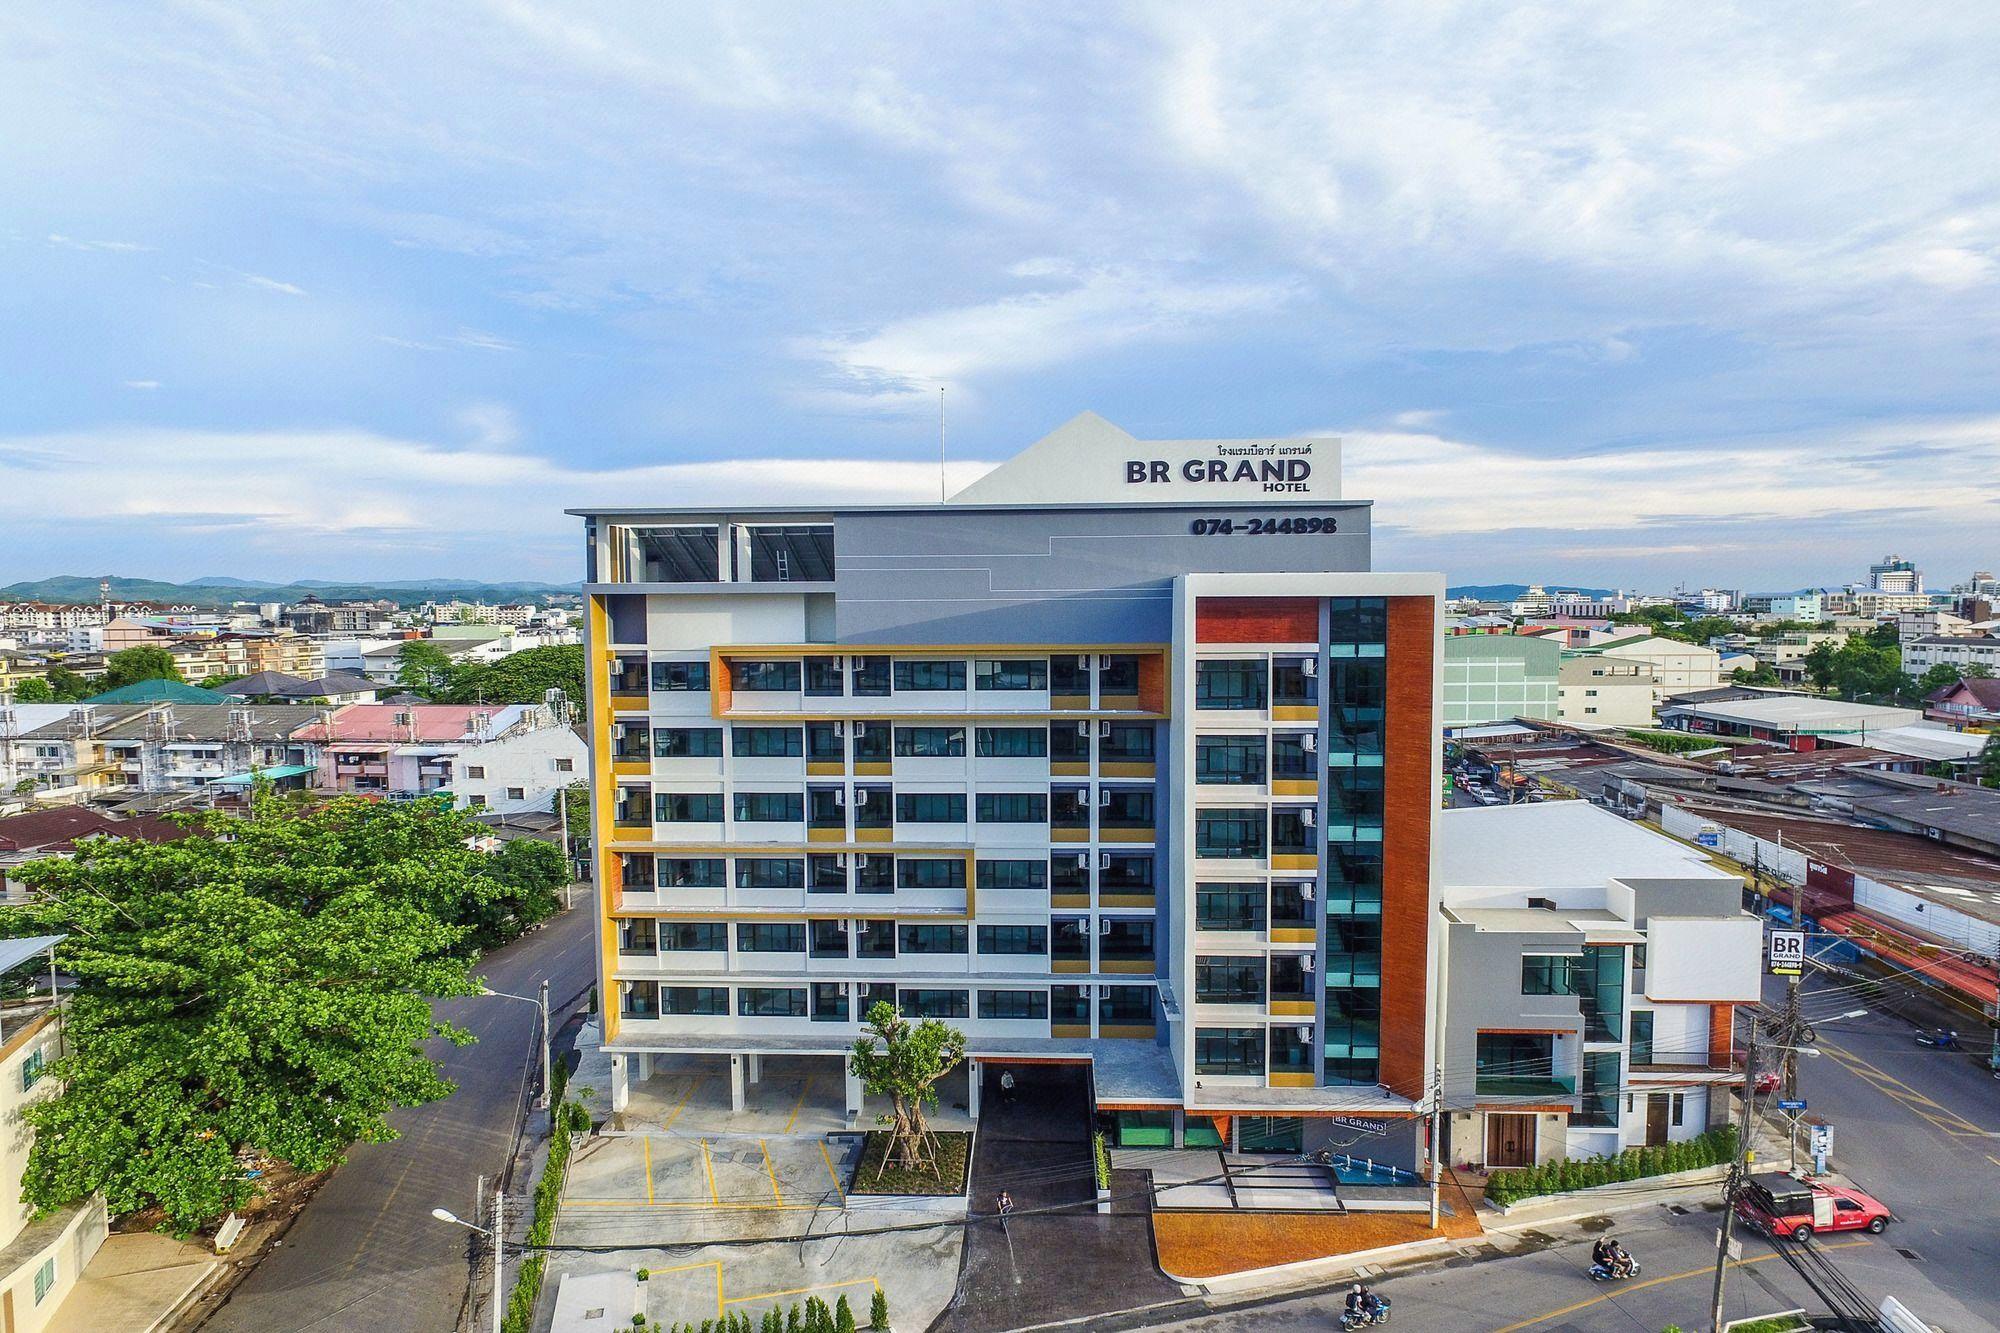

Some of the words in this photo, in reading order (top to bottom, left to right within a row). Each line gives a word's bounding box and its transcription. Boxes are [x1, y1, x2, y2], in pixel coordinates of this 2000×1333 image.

[1217, 444, 1276, 456] โรงแรมบีอาร์
[1279, 443, 1312, 455] แกรนด์
[1127, 461, 1171, 483] BR
[1182, 459, 1312, 483] GRAND
[1263, 483, 1311, 492] HOTEL
[1192, 517, 1338, 536] 074-244898
[1774, 937, 1800, 953] BR
[1335, 1116, 1348, 1124] BR
[1349, 1118, 1384, 1130] GRAND
